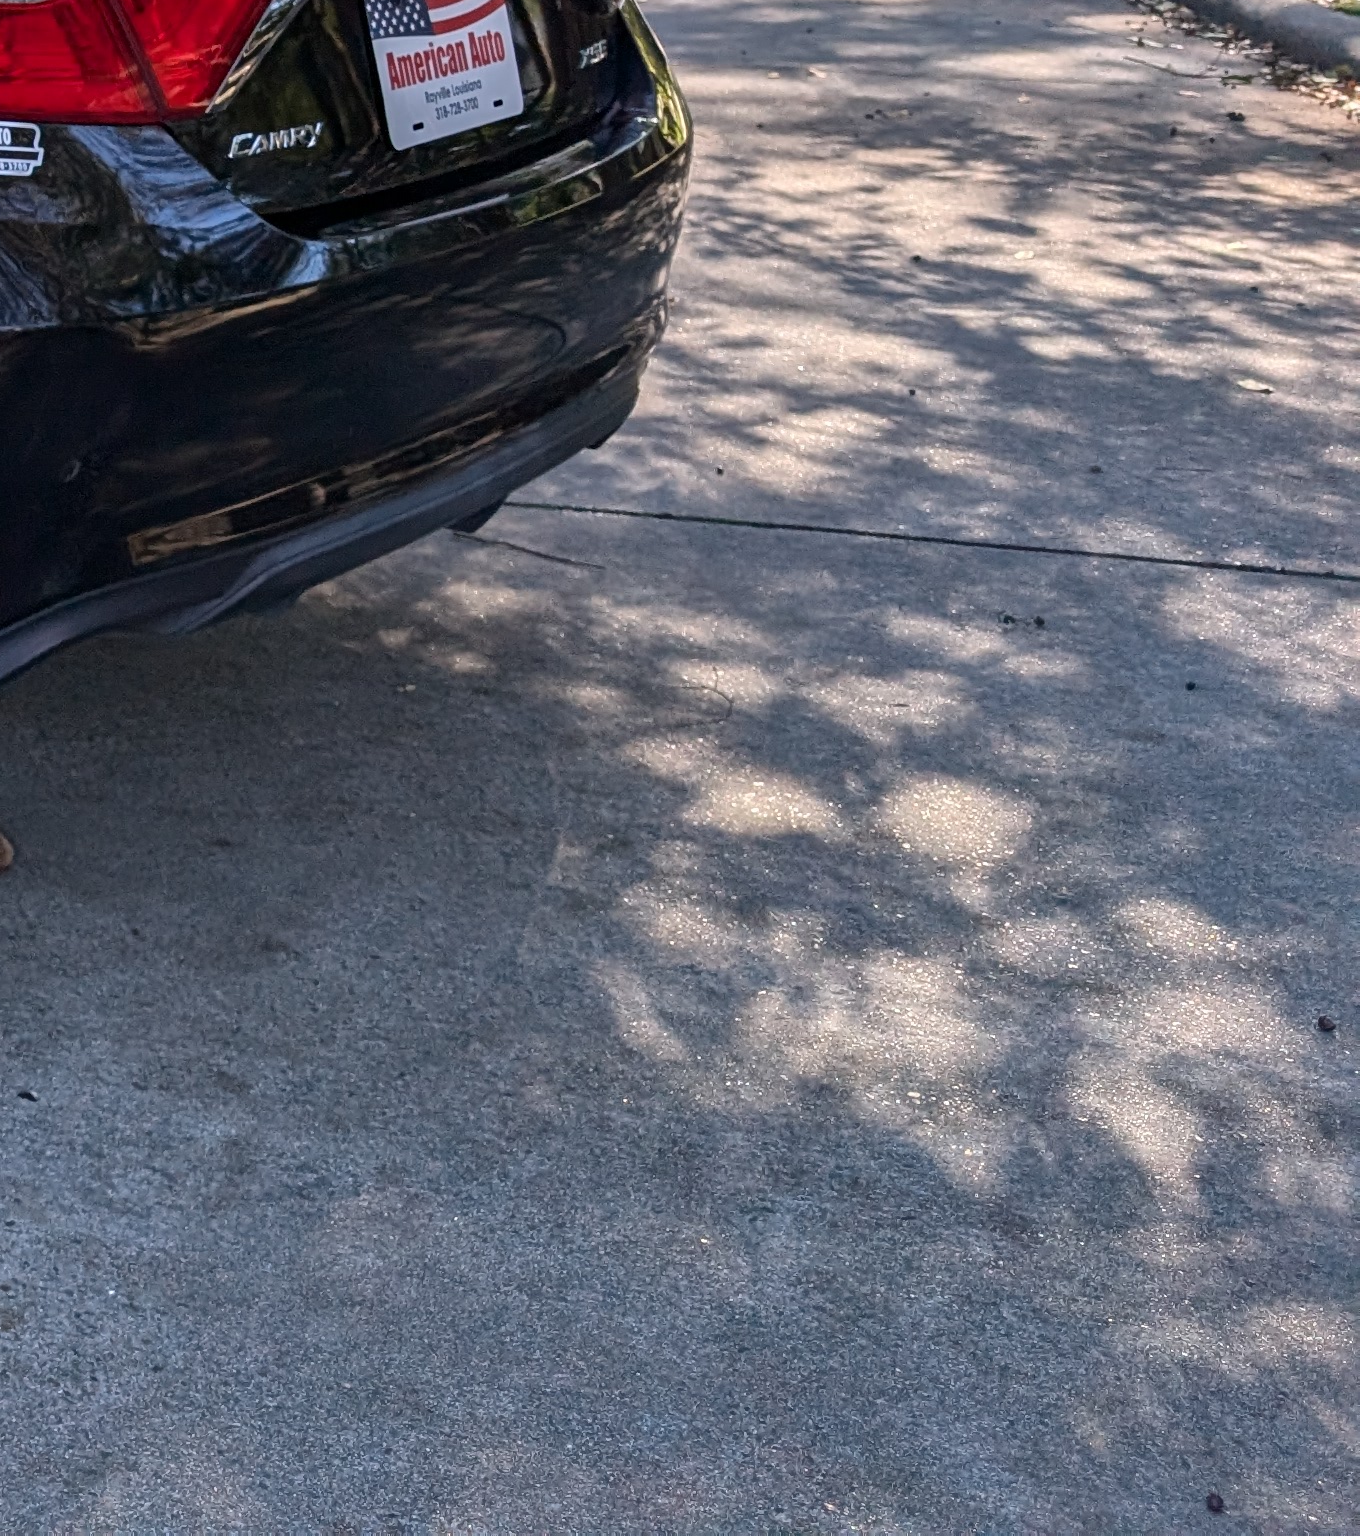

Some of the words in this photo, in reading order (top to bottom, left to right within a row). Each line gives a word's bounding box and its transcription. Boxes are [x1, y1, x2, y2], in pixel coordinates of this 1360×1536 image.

[385, 41, 469, 91] American
[468, 30, 506, 68] Auto
[451, 79, 482, 97] Louisiana
[228, 122, 323, 159] CAMRY
